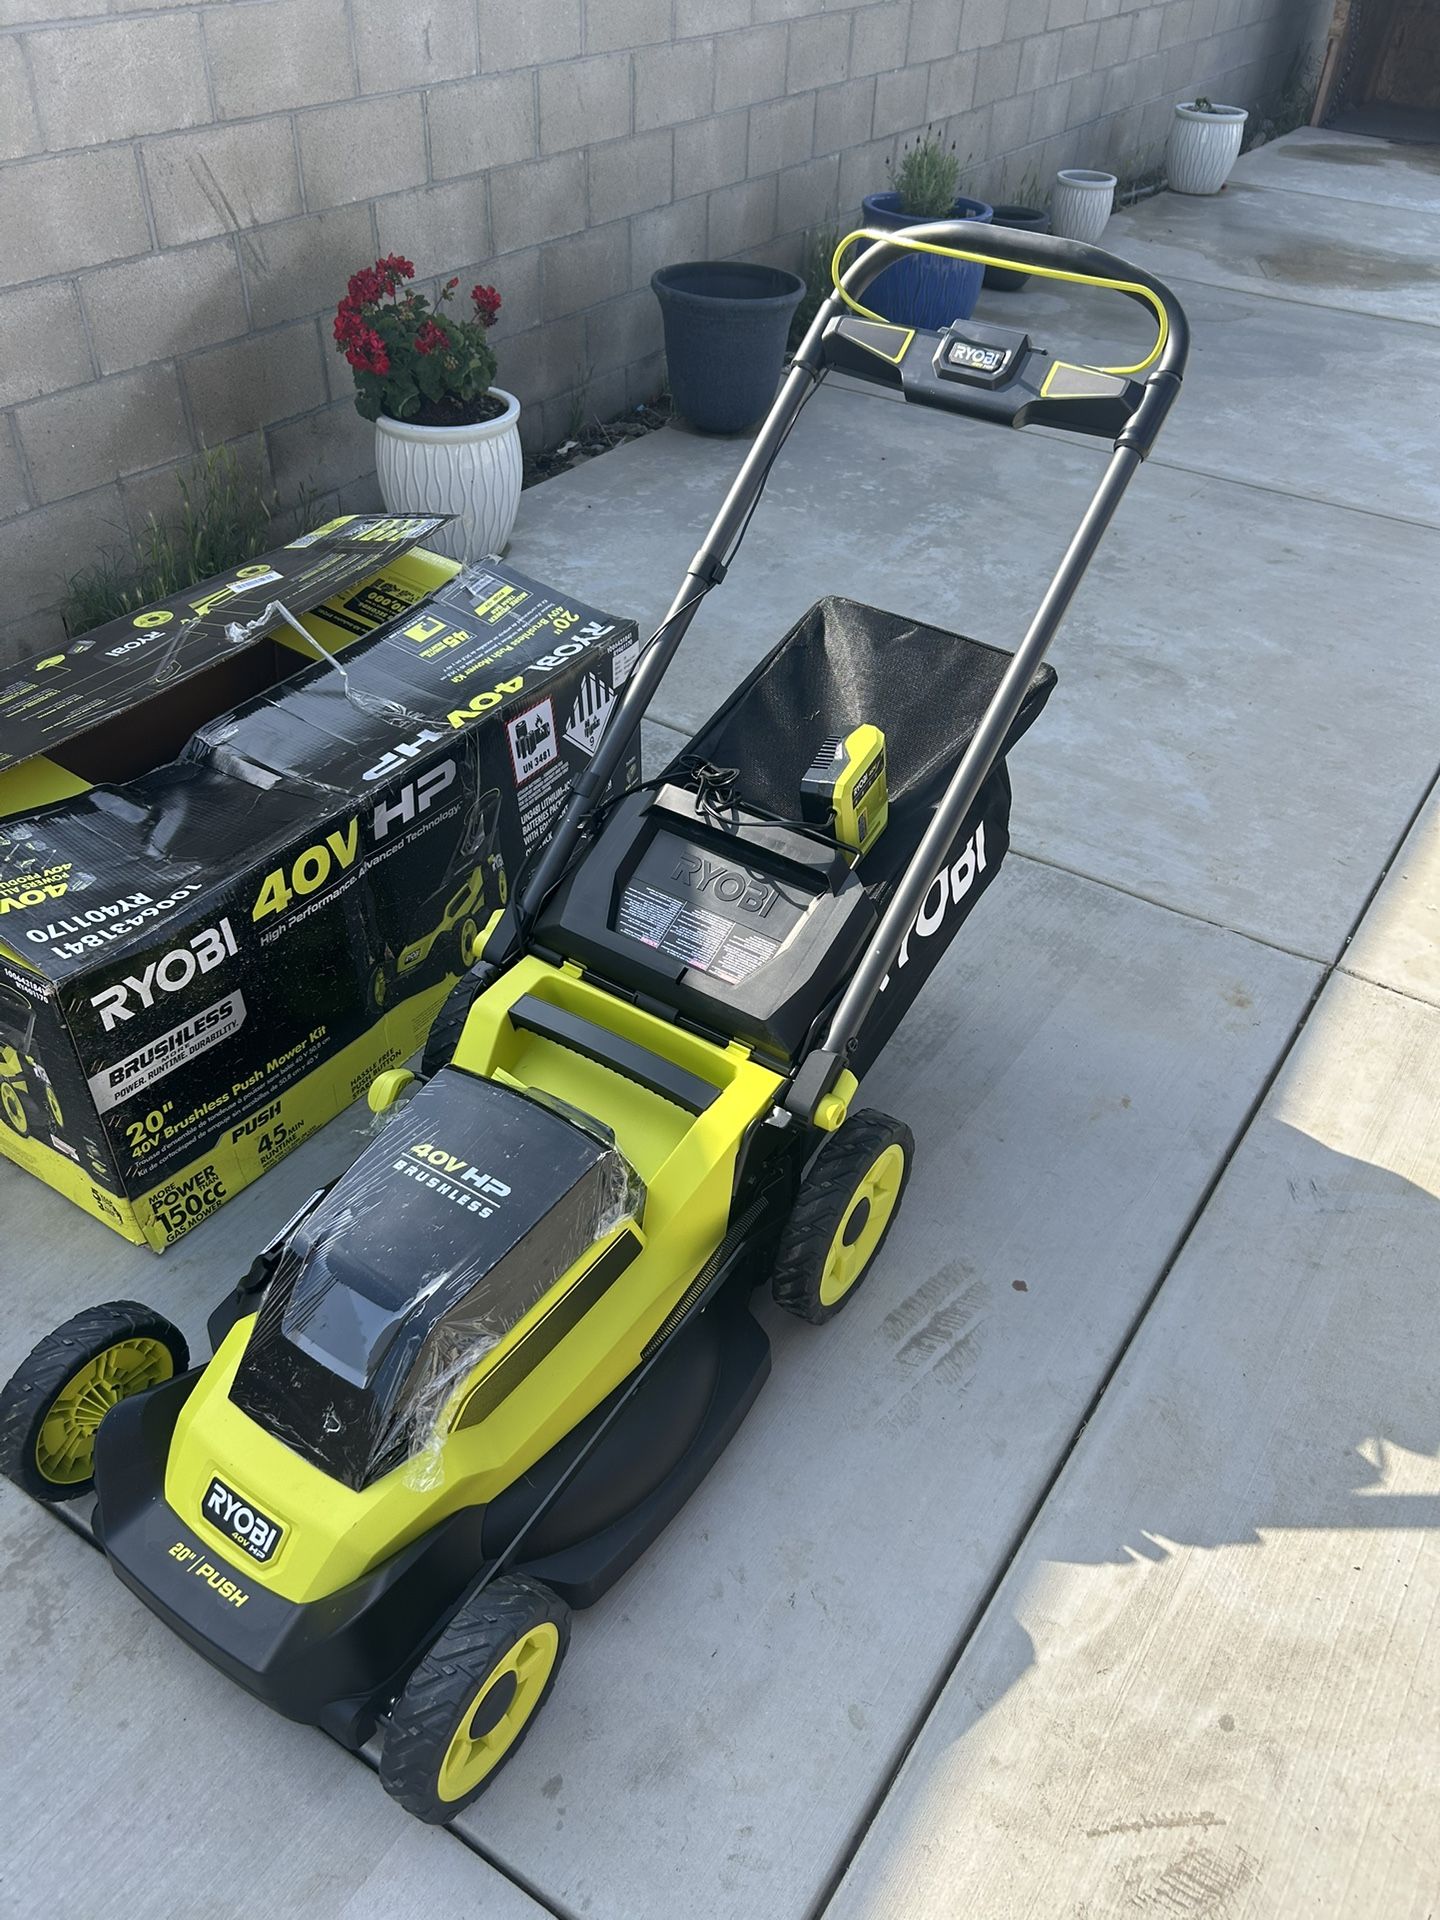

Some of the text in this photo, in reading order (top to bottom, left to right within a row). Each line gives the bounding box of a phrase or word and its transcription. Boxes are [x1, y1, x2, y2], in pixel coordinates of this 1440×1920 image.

[955, 345, 1000, 365] RYOBI
[105, 630, 166, 657] RYOBI
[443, 630, 469, 648] 45
[511, 618, 549, 646] Brushless
[552, 610, 580, 635] 20"
[464, 655, 495, 676] Mower
[495, 643, 514, 659] Push
[527, 621, 615, 672] RYOBI
[451, 672, 467, 684] Kit
[447, 675, 524, 729] 40V
[362, 729, 443, 781] HP
[523, 748, 551, 774] UN 3481
[252, 815, 358, 922] 40V
[374, 759, 457, 840] HP
[522, 809, 549, 836] BATTERIES
[523, 827, 539, 846] WITH
[0, 872, 70, 897] POWERS ALL
[44, 862, 72, 877] 40V
[671, 852, 780, 918] RYOBI
[0, 882, 68, 915] 40V
[26, 892, 153, 943] RY401170
[51, 883, 202, 960] 1006431841
[260, 922, 286, 946] High
[90, 916, 239, 1032] RYOBI
[109, 1000, 233, 1089] BRUSHLESS
[114, 1019, 239, 1101] POWER. RUNTIME. DURABILITY.
[161, 1042, 191, 1063] MORE
[350, 1047, 394, 1087] HASSLE FREE
[351, 1048, 402, 1093] PUSH BUTTON
[131, 1025, 327, 1158] 40V Brushless Push Mower Kit
[125, 1101, 174, 1148] 20"
[134, 1150, 161, 1167] Trousse
[198, 1120, 207, 1130] de
[232, 1101, 282, 1145] PUSH
[258, 1119, 305, 1153] 45 MIN
[137, 1167, 148, 1177] Kit
[149, 1161, 158, 1171] de
[198, 1129, 207, 1139] de
[207, 1115, 231, 1135] empuje
[260, 1134, 298, 1164] RUNTIME
[151, 1165, 218, 1214] POWER
[199, 1174, 219, 1191] THAN
[392, 1159, 494, 1219] BRUSHLESS
[410, 1143, 512, 1197] 40V HP
[148, 1182, 177, 1204] MORE
[166, 1199, 222, 1243] GAS MOWER
[207, 1482, 277, 1553] RYOBI
[231, 1531, 266, 1559] 40V HP
[168, 1542, 250, 1608] 20" PUSH
